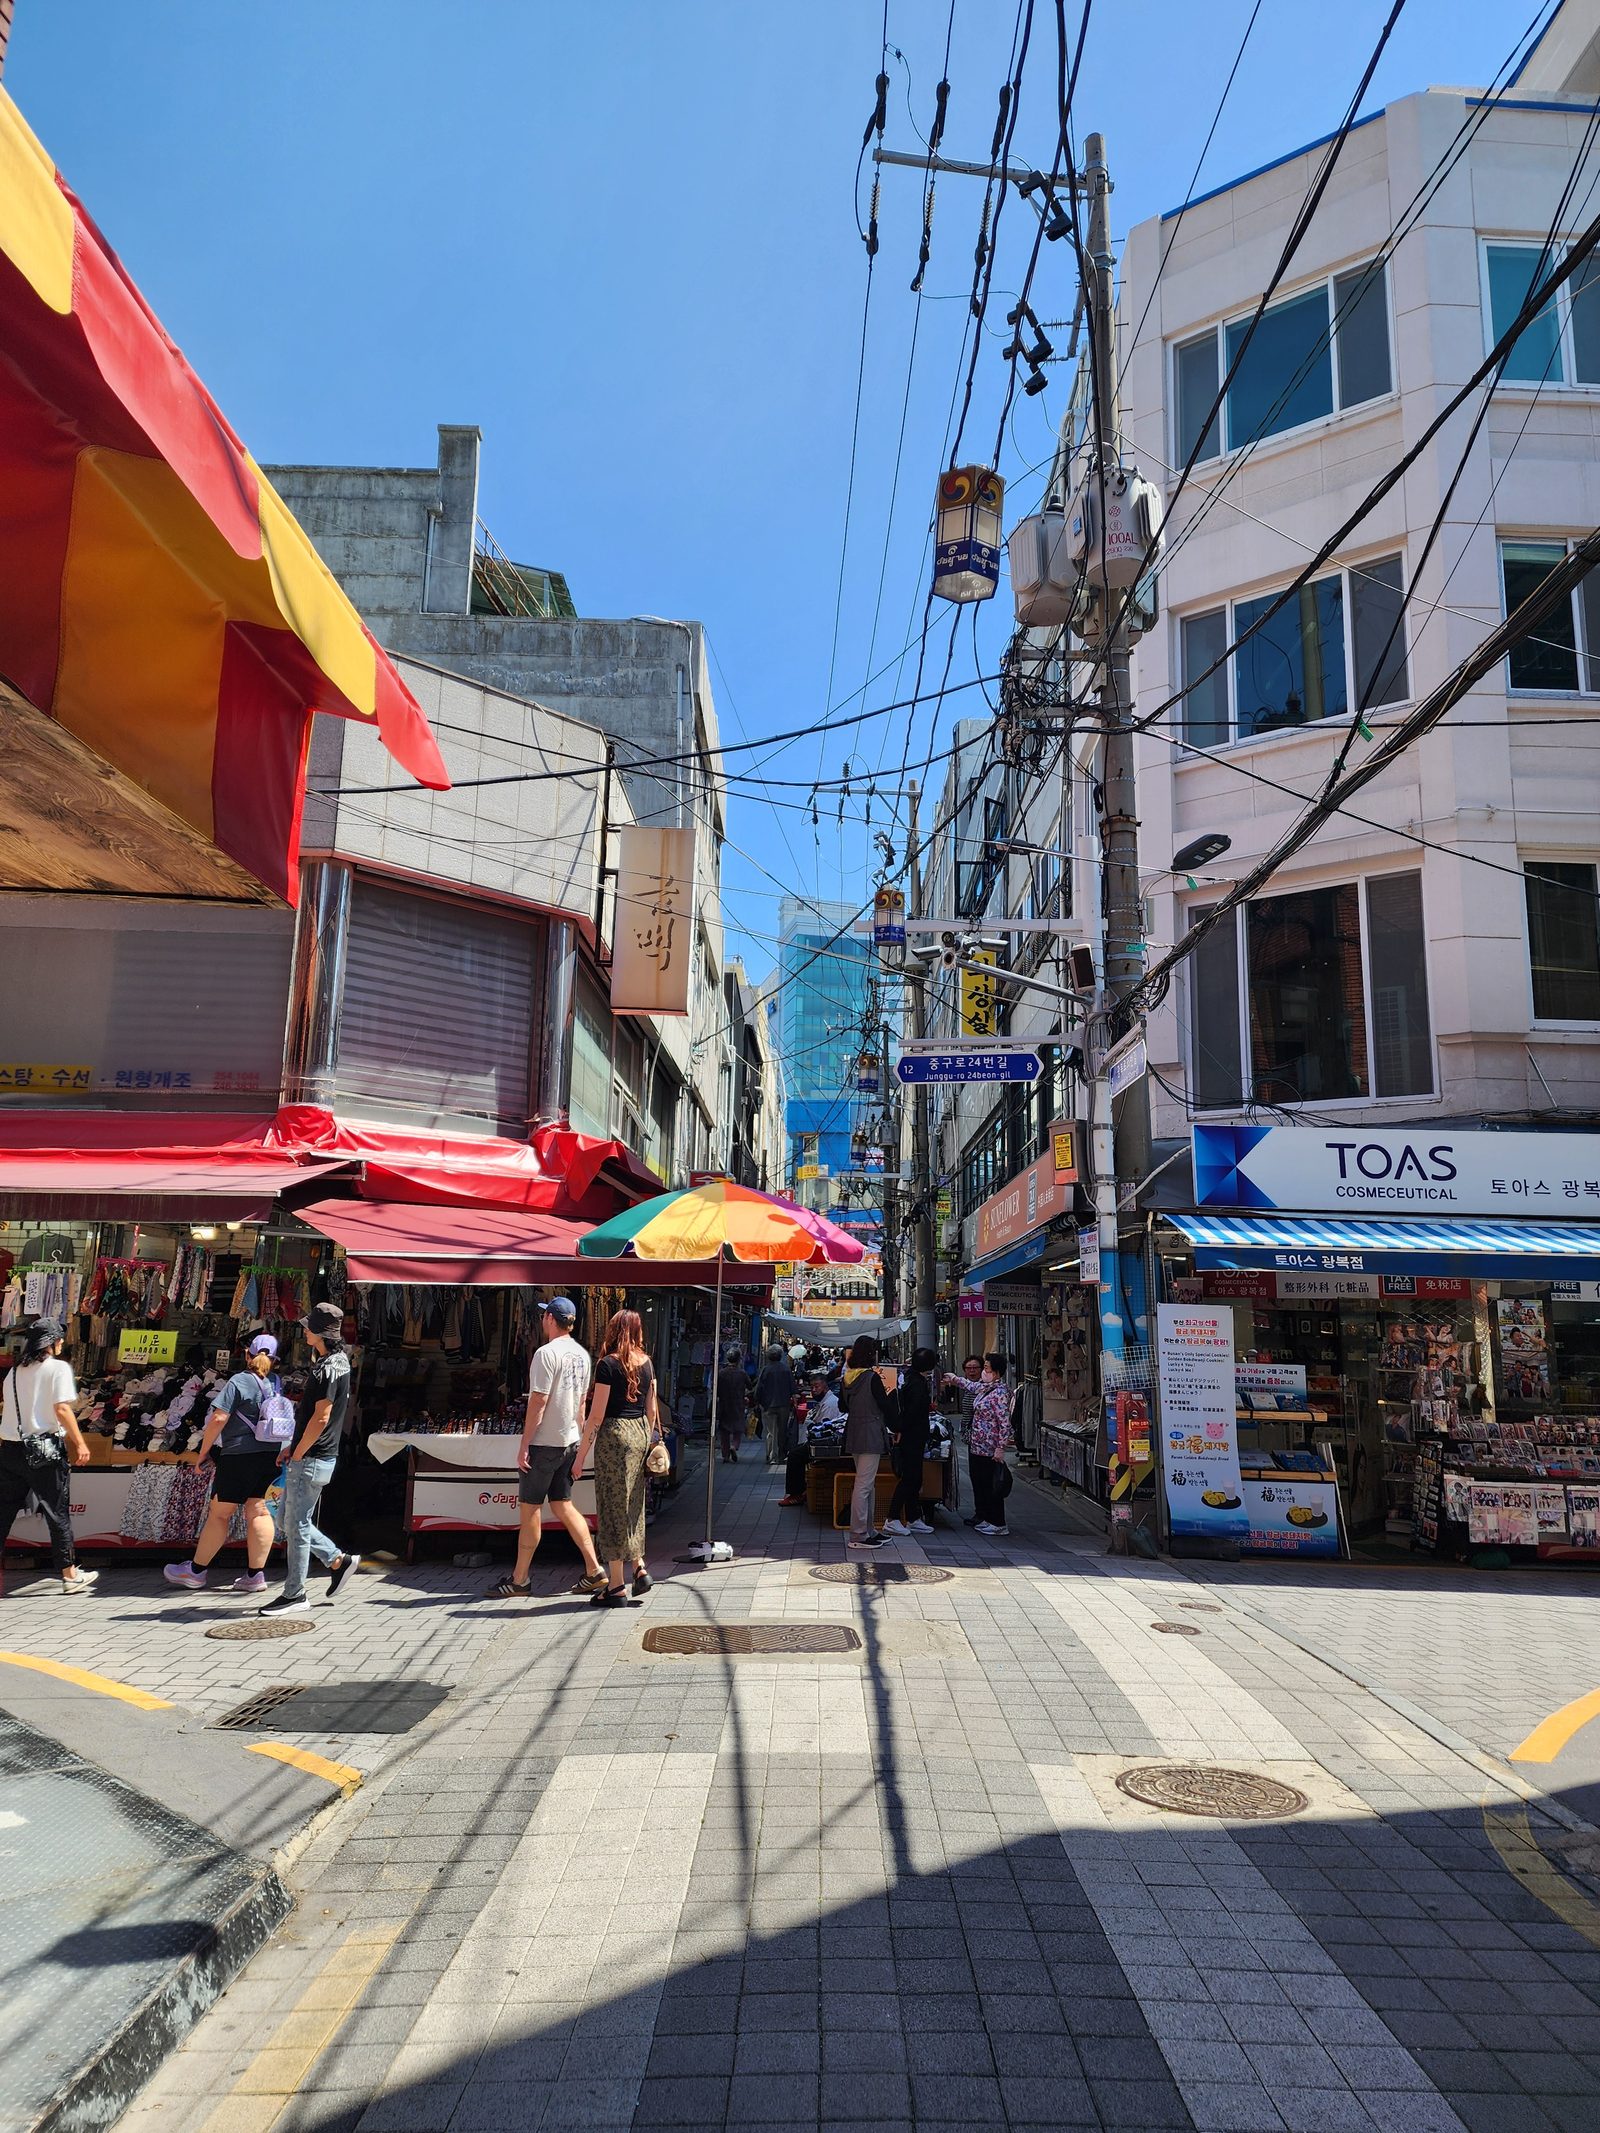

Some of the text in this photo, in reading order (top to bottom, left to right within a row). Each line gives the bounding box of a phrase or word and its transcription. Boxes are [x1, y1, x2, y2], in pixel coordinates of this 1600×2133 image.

[903, 1065, 914, 1074] 12
[1026, 1062, 1033, 1071] 8
[52, 1068, 91, 1088] 수선
[115, 1070, 192, 1088] 원형개조
[925, 1071, 1011, 1080] Junggu-ro 24beon-gil
[1325, 1143, 1458, 1181] TOAS
[1336, 1185, 1458, 1200] COSMECEUTICAL
[1490, 1178, 1552, 1197] 토아스
[1275, 1254, 1364, 1270] 토아스 광복점
[1209, 1287, 1267, 1296] 토아스 광복점
[1284, 1282, 1330, 1293] 整形外科
[1388, 1283, 1412, 1291] FREE
[1553, 1281, 1577, 1290] FREE
[139, 1334, 147, 1344] 10
[1171, 1469, 1187, 1486] 福
[1261, 1486, 1276, 1502] 福
